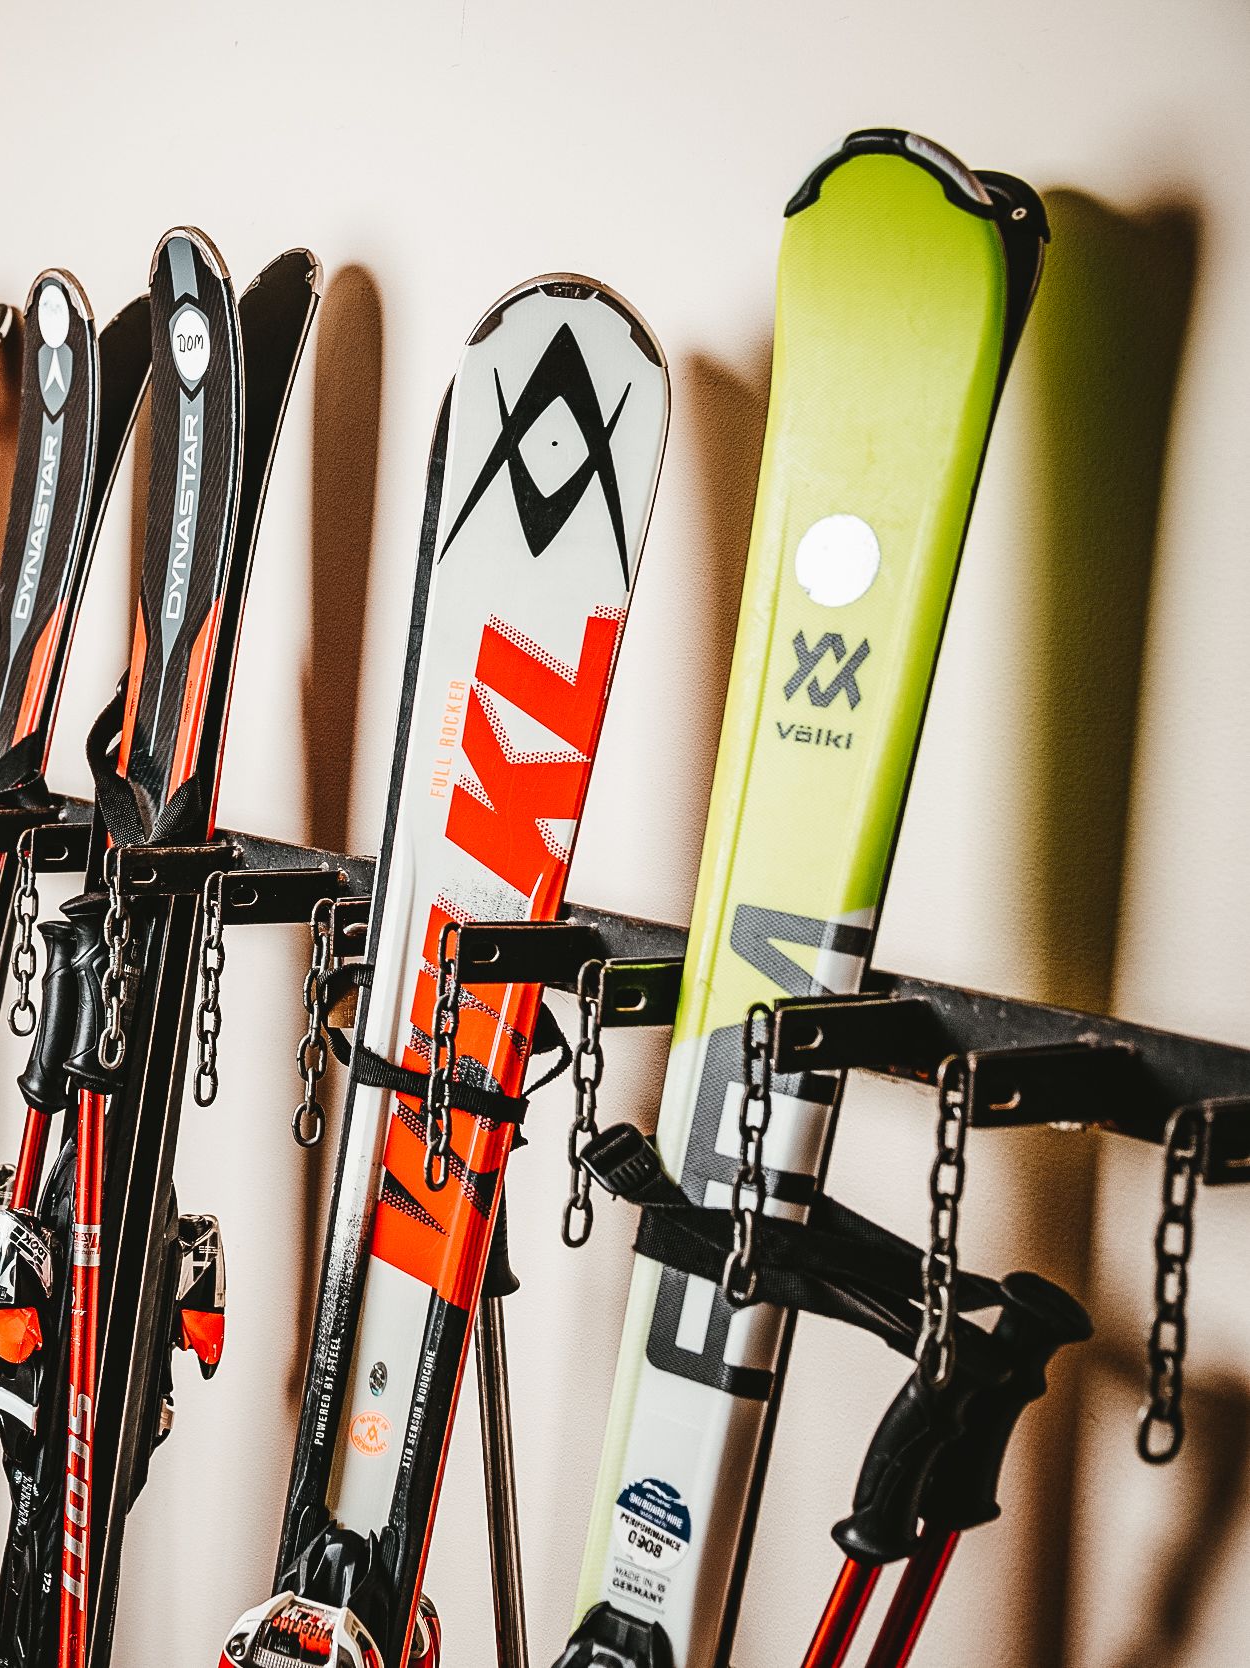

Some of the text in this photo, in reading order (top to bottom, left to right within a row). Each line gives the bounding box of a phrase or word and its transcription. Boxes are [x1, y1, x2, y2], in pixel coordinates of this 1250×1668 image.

[176, 333, 204, 353] DOM
[14, 435, 59, 620] DYNASTAR
[165, 414, 199, 620] DYNASTAR
[430, 680, 466, 798] FULL ROCKER
[776, 722, 853, 750] Völkl
[21, 1231, 48, 1261] LOOK
[314, 1337, 341, 1446] POWERED BY STEEL
[408, 1406, 424, 1446] SENSOR
[416, 1349, 437, 1403] WOODCORE
[65, 1384, 93, 1612] SCOTT
[41, 1572, 53, 1594] 172
